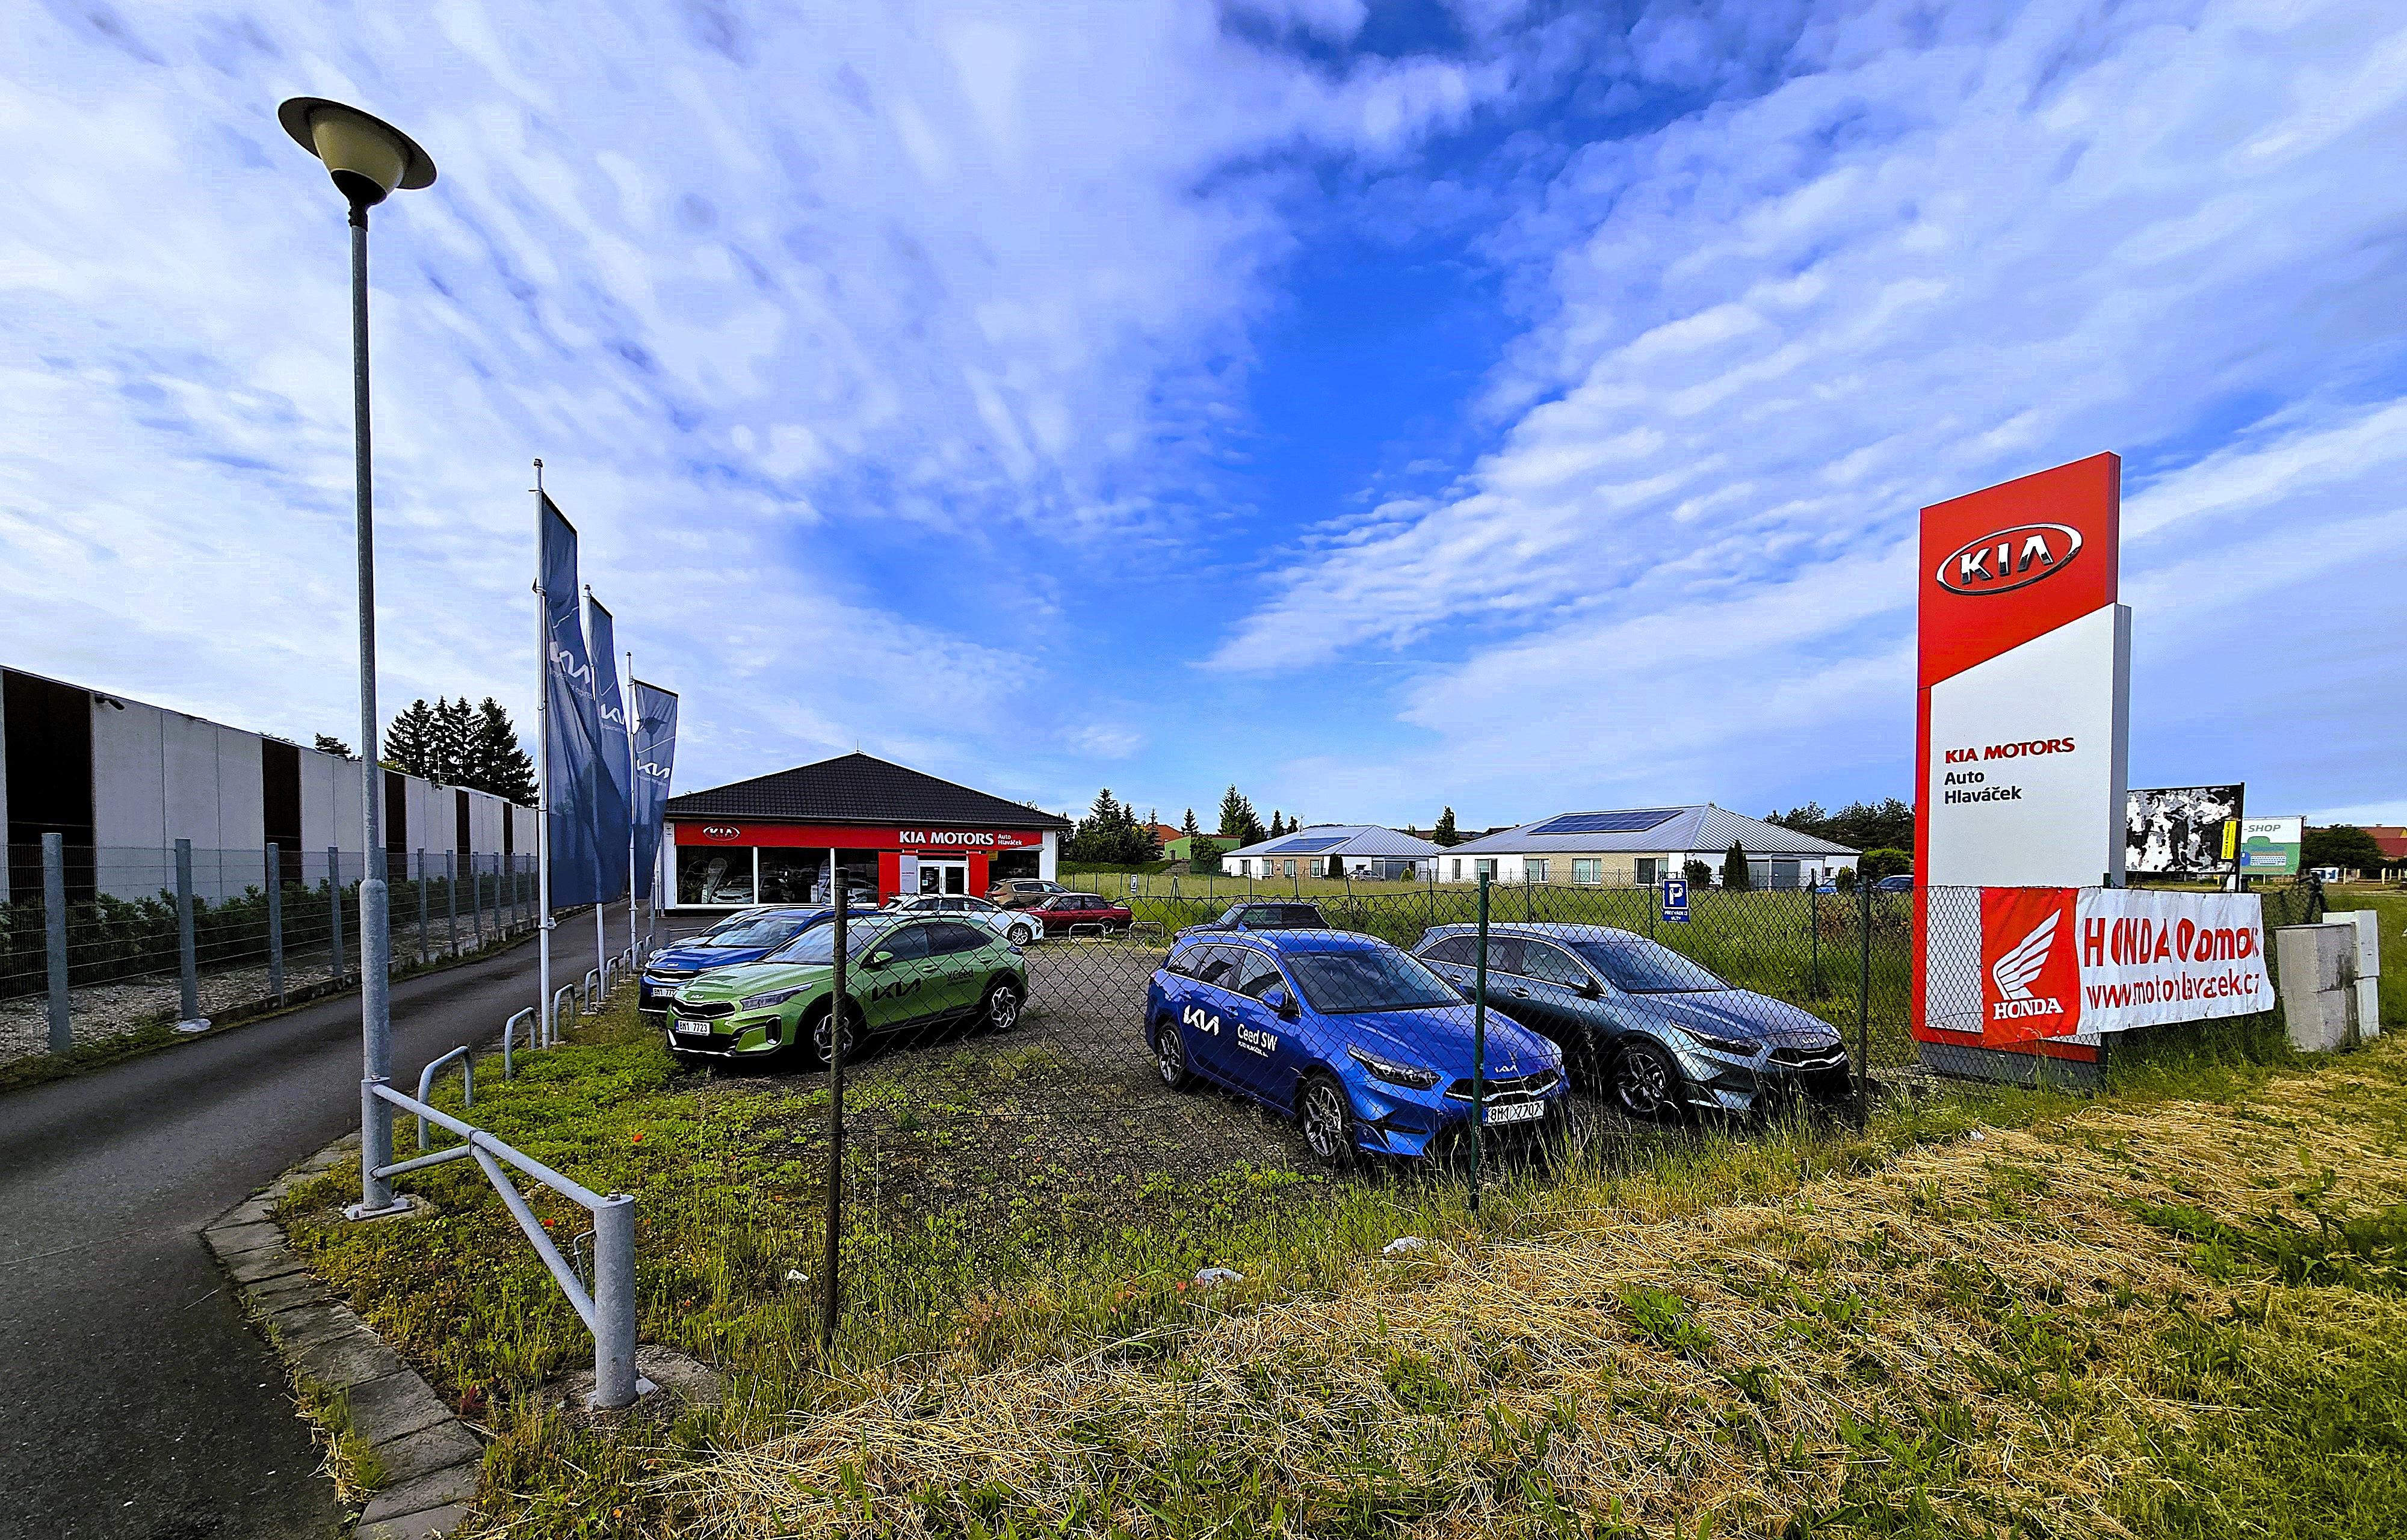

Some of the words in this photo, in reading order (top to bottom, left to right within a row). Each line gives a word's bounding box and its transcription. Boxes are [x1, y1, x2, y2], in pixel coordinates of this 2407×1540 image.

[1959, 534, 2054, 585] KIA
[1945, 748, 1979, 764] KIA
[1983, 737, 2075, 760] MOTORS
[1944, 771, 1985, 786] Auto
[1944, 785, 2022, 804] Hlaváček
[899, 831, 927, 843] KIA
[930, 832, 994, 845] MOTORS
[1669, 883, 1683, 904] P
[947, 967, 974, 981] XCeed
[1993, 997, 2064, 1020] HONDA
[693, 1023, 708, 1032] 7723
[1237, 1023, 1260, 1045] Ceed
[1261, 1032, 1278, 1052] SW
[1491, 1107, 1509, 1121] 8M1
[1516, 1103, 1540, 1118] 7707
